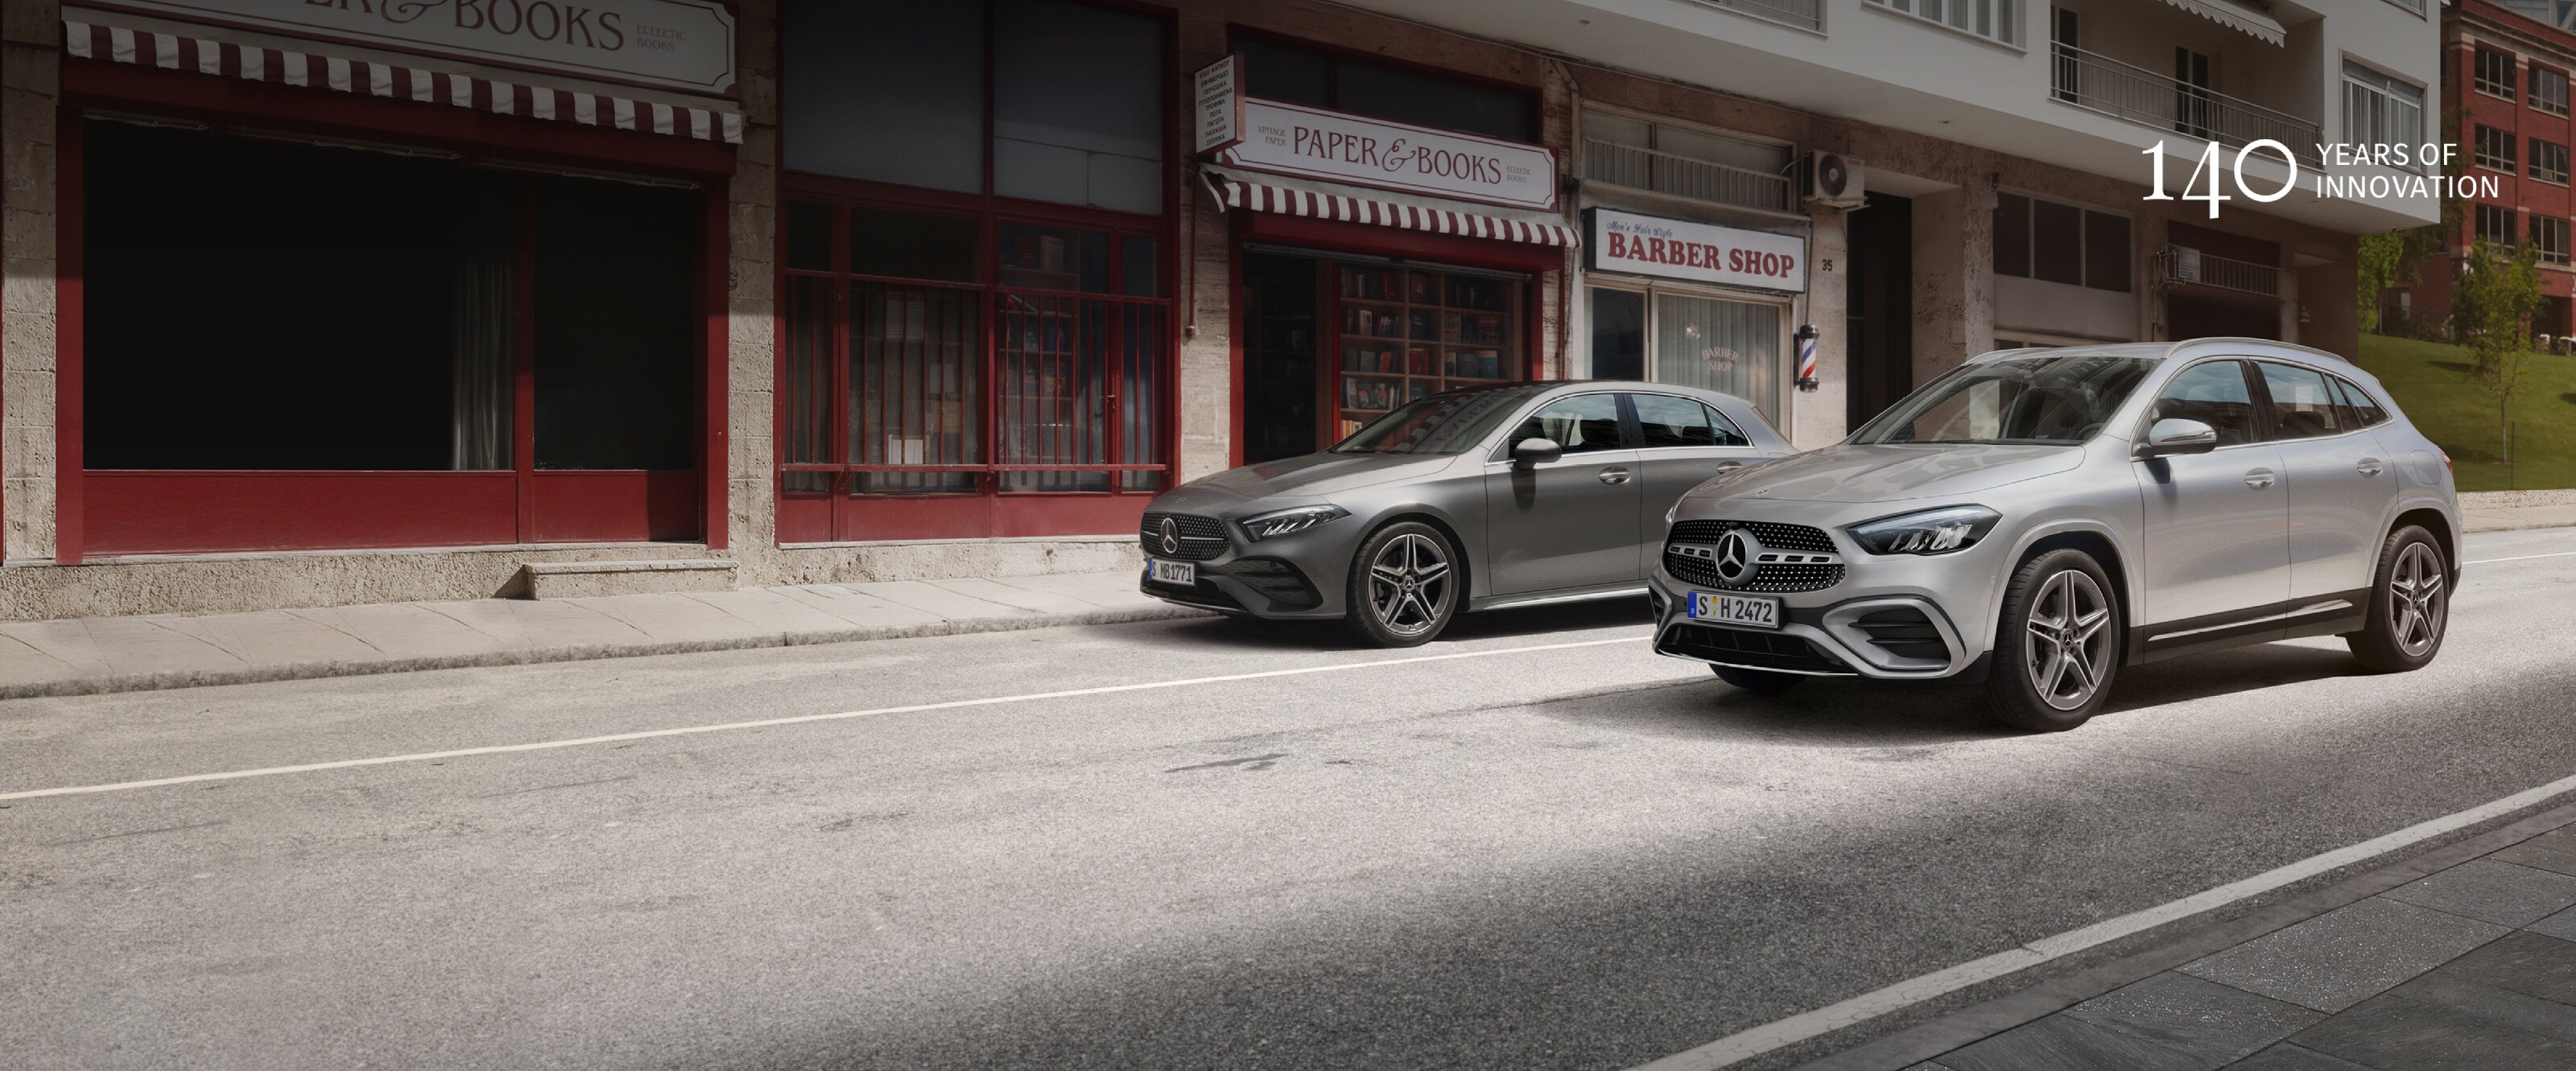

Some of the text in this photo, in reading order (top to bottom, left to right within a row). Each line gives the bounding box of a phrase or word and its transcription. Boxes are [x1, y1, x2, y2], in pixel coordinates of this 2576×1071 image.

[454, 0, 624, 51] BOOKS
[637, 24, 687, 41] ECLECTIC
[637, 37, 675, 51] BOOKS
[1257, 125, 1286, 137] VINTAGE
[1265, 136, 1286, 146] PAPER
[1294, 126, 1501, 185] PAPER & BOOKS
[1506, 165, 1532, 176] ECLECTIC
[1506, 173, 1526, 183] BOOKS
[1607, 220, 1674, 240] Men's Hair Style
[1608, 232, 1794, 278] BARBER SHOP
[1822, 258, 1833, 272] 35
[1701, 346, 1740, 363] BARBER
[1708, 360, 1733, 372] SHOP
[1153, 562, 1157, 577] S
[1699, 596, 1772, 622] S H 2472
